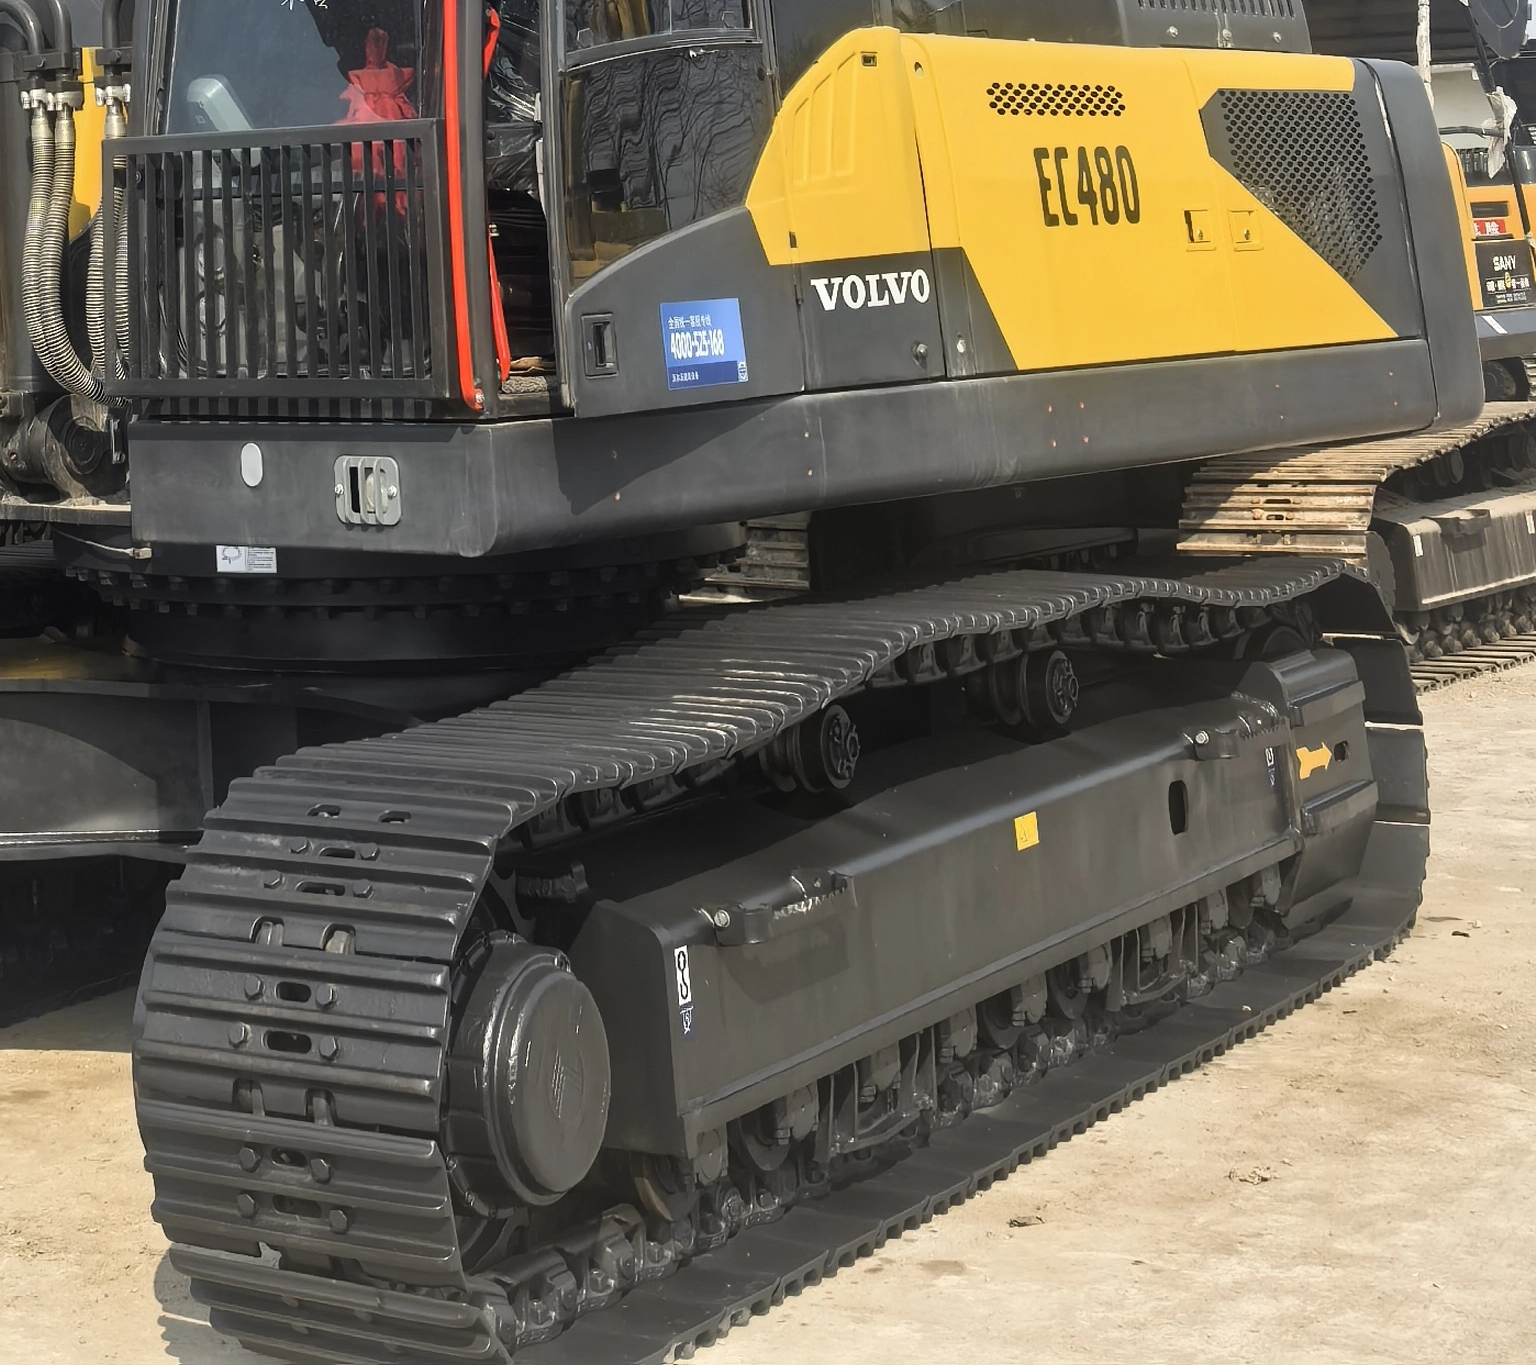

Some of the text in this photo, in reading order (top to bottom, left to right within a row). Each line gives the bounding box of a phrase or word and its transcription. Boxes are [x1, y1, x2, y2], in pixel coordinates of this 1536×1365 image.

[1033, 145, 1140, 227] EC480
[1492, 254, 1517, 272] SANY
[810, 268, 930, 311] VOLVO
